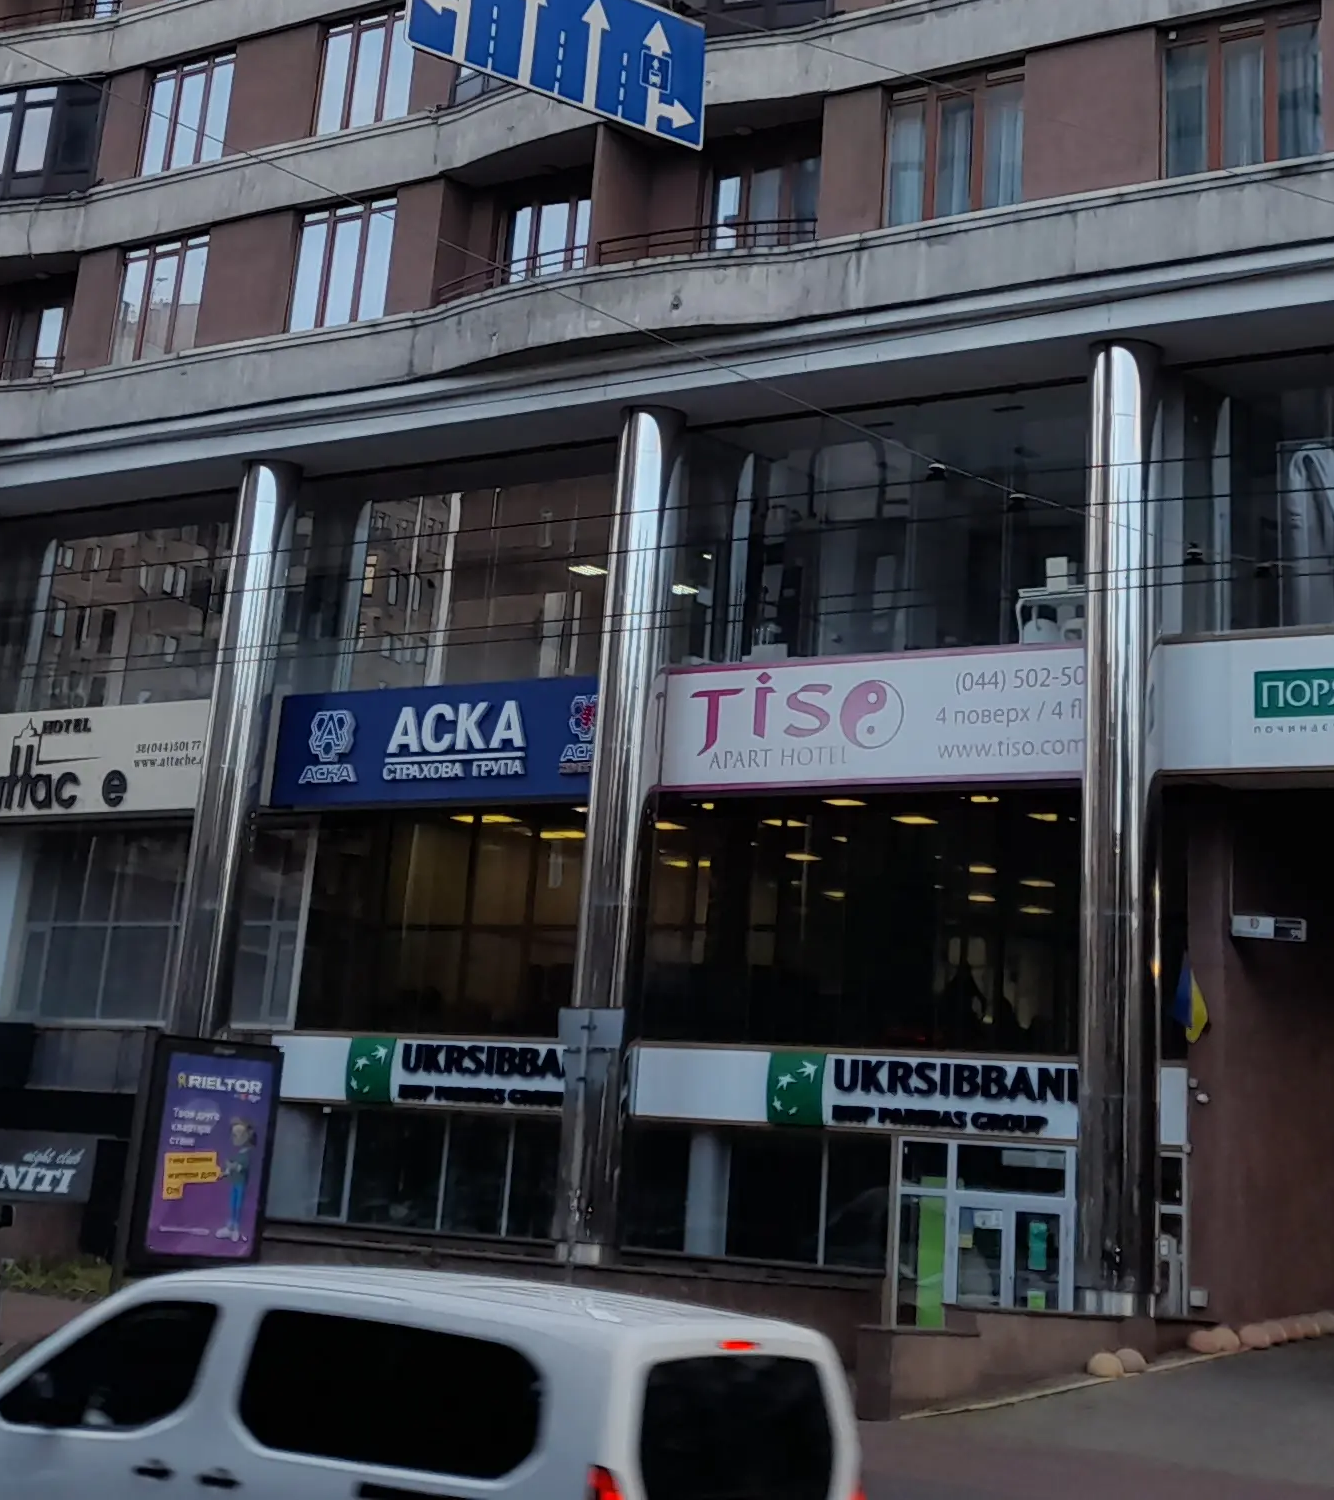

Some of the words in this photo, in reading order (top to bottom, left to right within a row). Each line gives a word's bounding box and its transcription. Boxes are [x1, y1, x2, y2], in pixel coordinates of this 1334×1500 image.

[955, 669, 1007, 695] (044)
[935, 706, 947, 724] 4
[954, 707, 1031, 727] поверх
[1051, 700, 1063, 720] 4
[41, 718, 92, 735] HOTEL
[386, 700, 527, 754] АСКА
[383, 761, 464, 780] СТРАХОВА
[471, 759, 526, 777] ГРУПА
[709, 749, 773, 770] APART
[780, 745, 848, 766] HOTEL
[298, 763, 359, 784] АСКА
[401, 1043, 565, 1080] UKRSIBBA
[187, 1074, 263, 1095] RIELTOR
